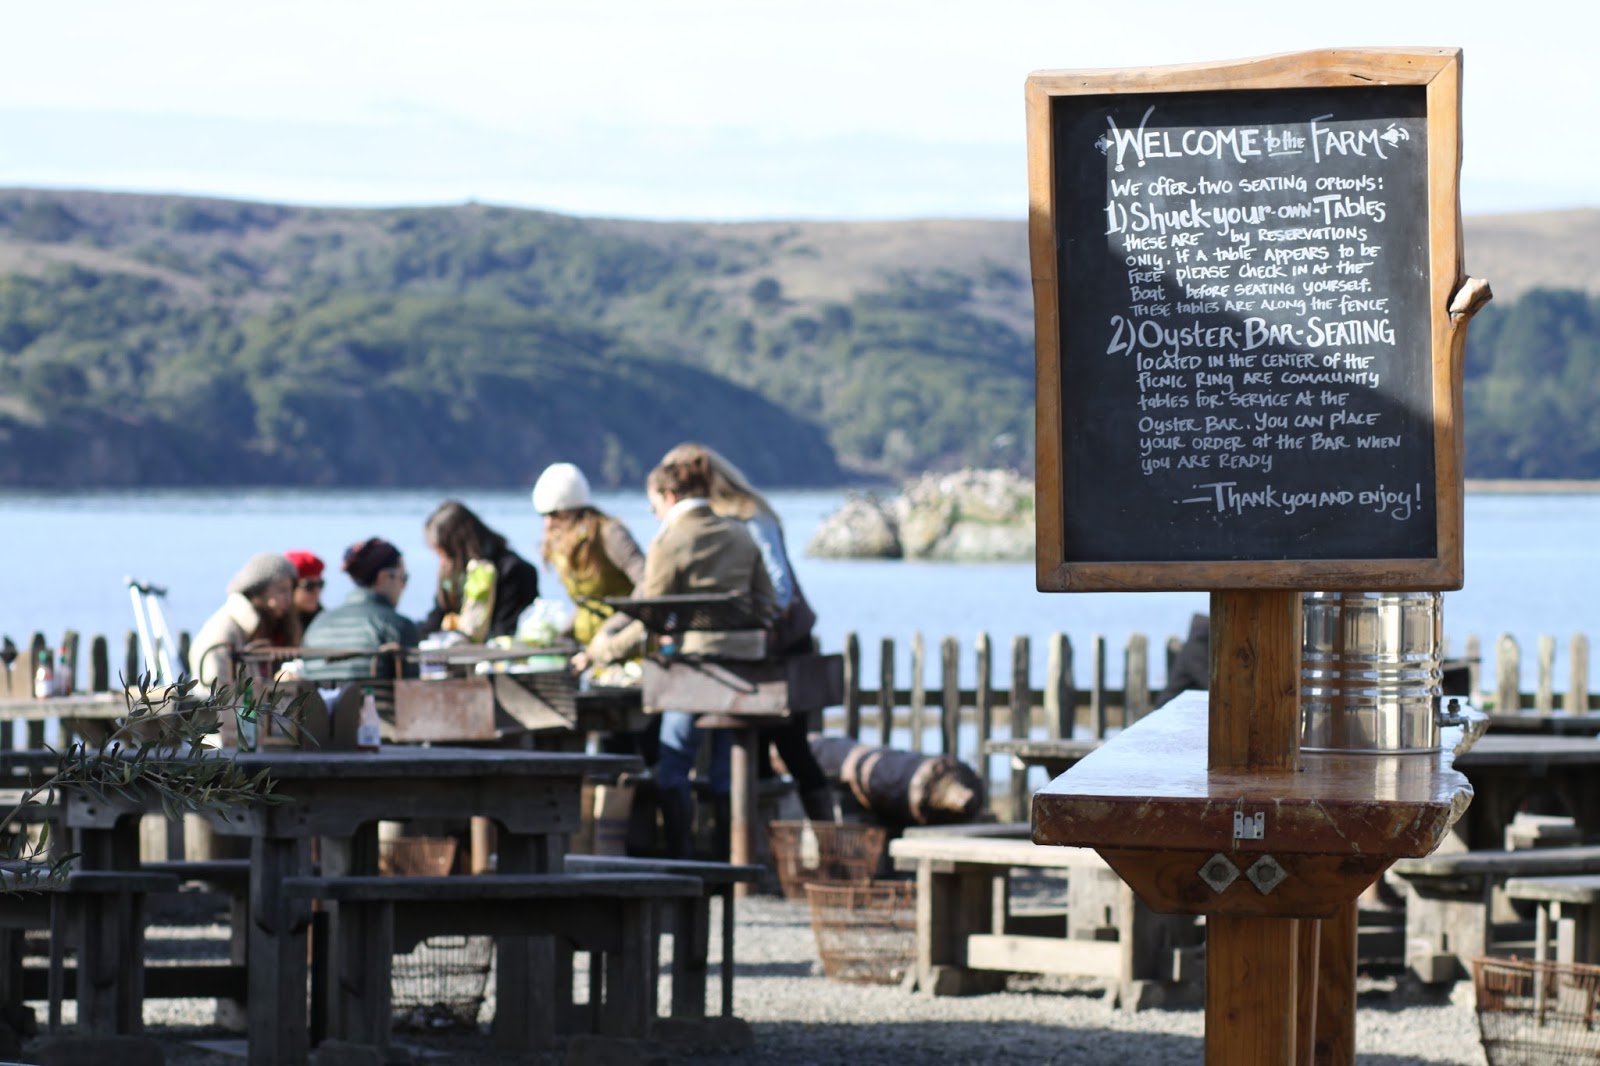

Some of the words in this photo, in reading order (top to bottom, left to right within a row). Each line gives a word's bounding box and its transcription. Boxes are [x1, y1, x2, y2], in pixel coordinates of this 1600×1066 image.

[1107, 105, 1261, 172] WELCOME
[1311, 114, 1388, 163] FARM
[1239, 175, 1307, 192] SEATING
[1171, 232, 1204, 247] ARE
[1230, 229, 1250, 248] by
[1196, 249, 1208, 261] A
[1264, 247, 1330, 265] APPEARS
[1338, 244, 1354, 258] to
[1128, 268, 1165, 284] FREE
[1292, 264, 1308, 276] IN
[1234, 282, 1295, 296] SEATING
[1129, 303, 1171, 317] THESE
[1225, 300, 1256, 312] ARE
[1208, 354, 1223, 368] IN
[1261, 353, 1319, 368] CENTER
[1243, 372, 1273, 385] ARE
[1294, 414, 1324, 428] CAN
[1192, 436, 1246, 452] ORDER
[1310, 432, 1351, 450] BAR
[1176, 454, 1211, 469] ARE
[1319, 491, 1354, 507] AND
